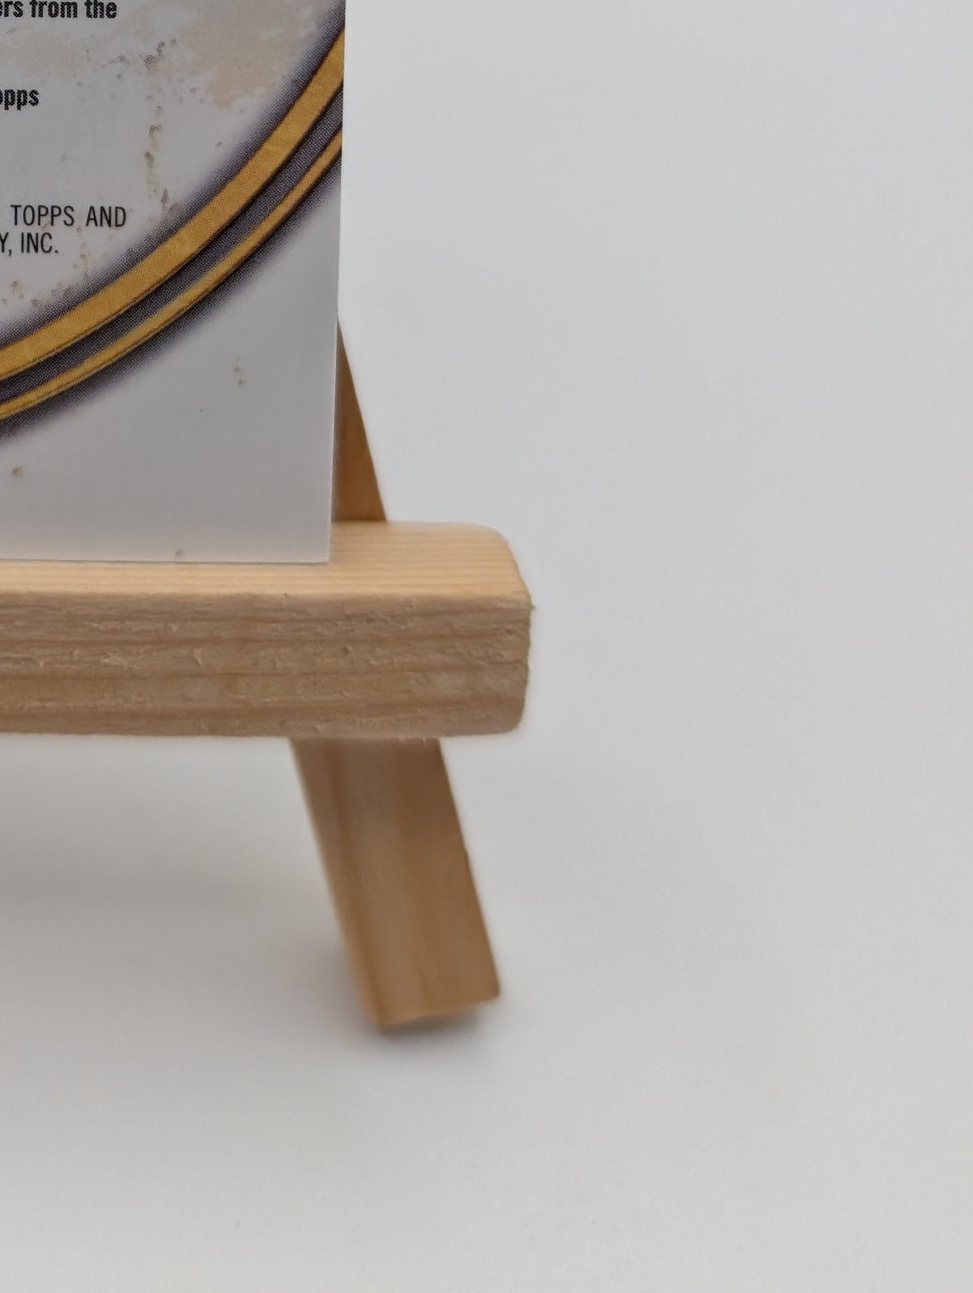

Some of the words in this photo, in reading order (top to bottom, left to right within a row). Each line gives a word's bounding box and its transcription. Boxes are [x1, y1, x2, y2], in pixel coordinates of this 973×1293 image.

[10, 205, 75, 228] TOPPS
[85, 206, 127, 228] AND
[20, 232, 59, 254] INC.
